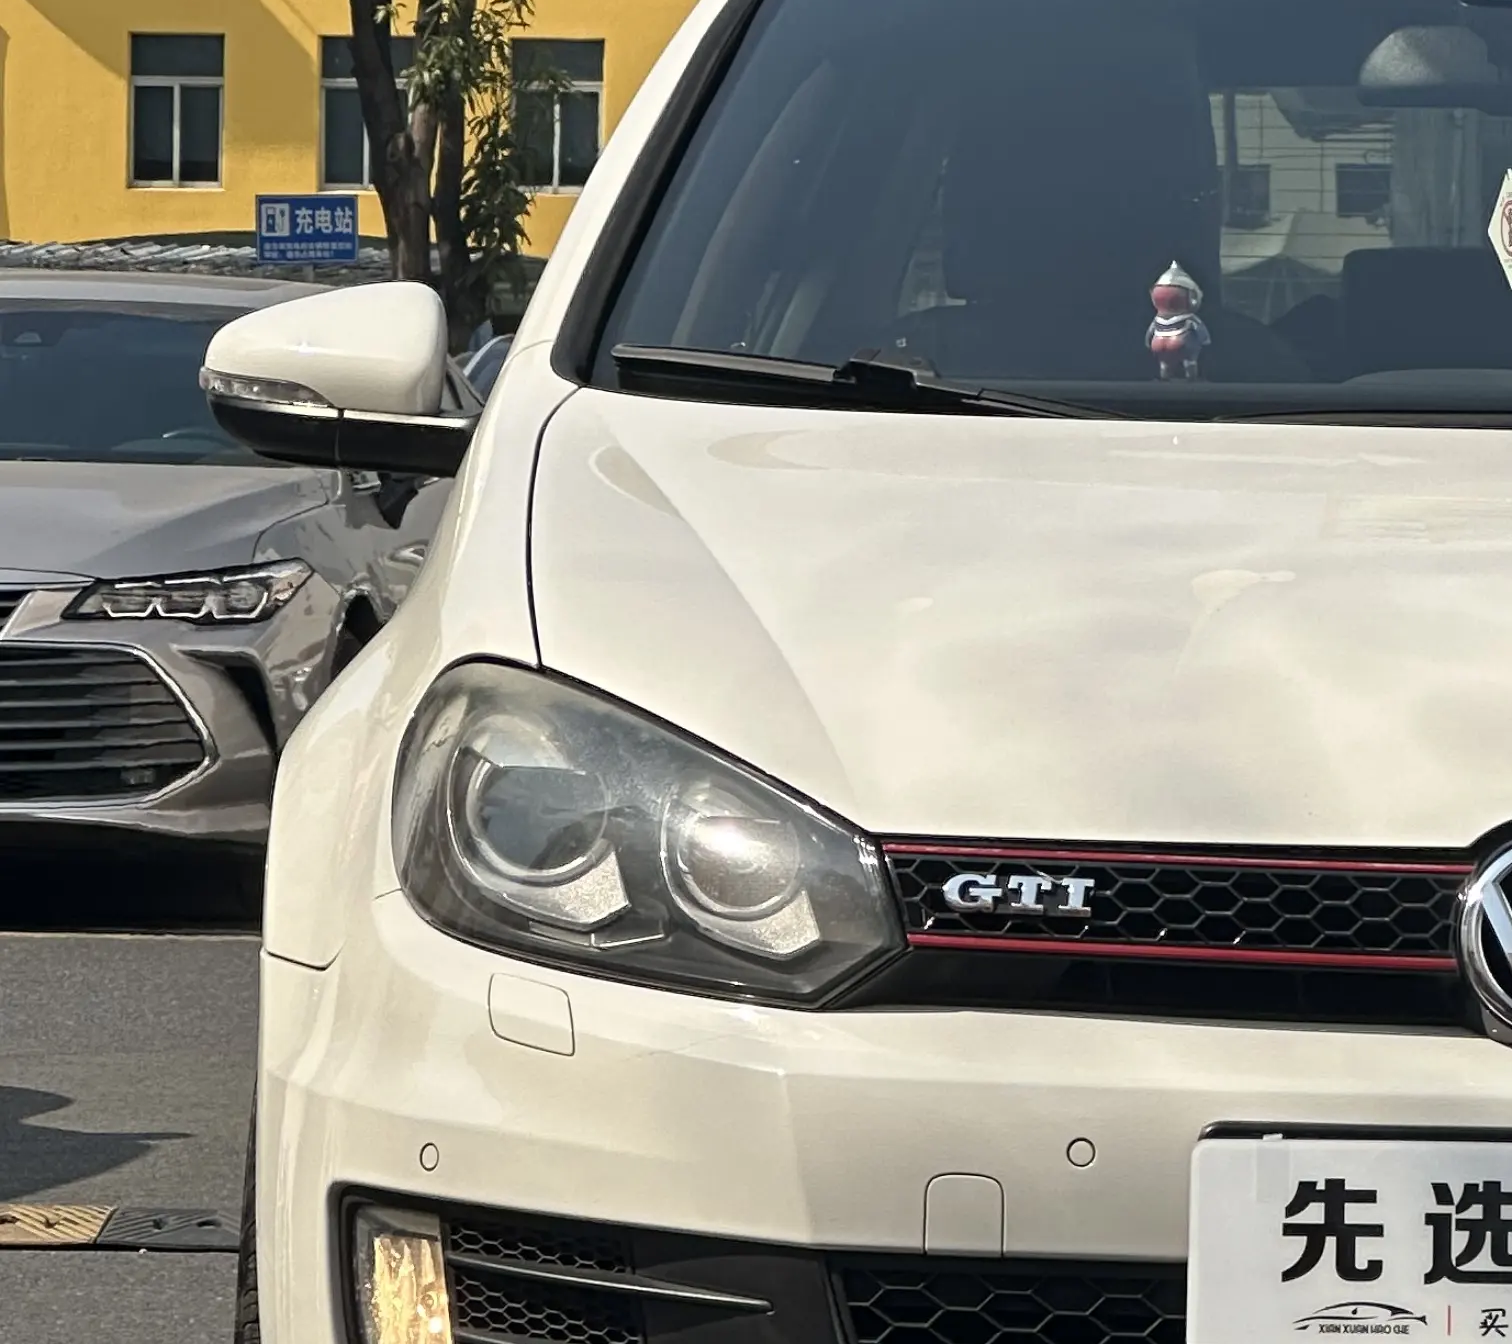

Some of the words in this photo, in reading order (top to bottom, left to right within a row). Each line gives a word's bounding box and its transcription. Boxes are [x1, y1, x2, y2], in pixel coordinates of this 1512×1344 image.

[294, 207, 353, 235] 充电站
[942, 873, 1095, 917] GTI
